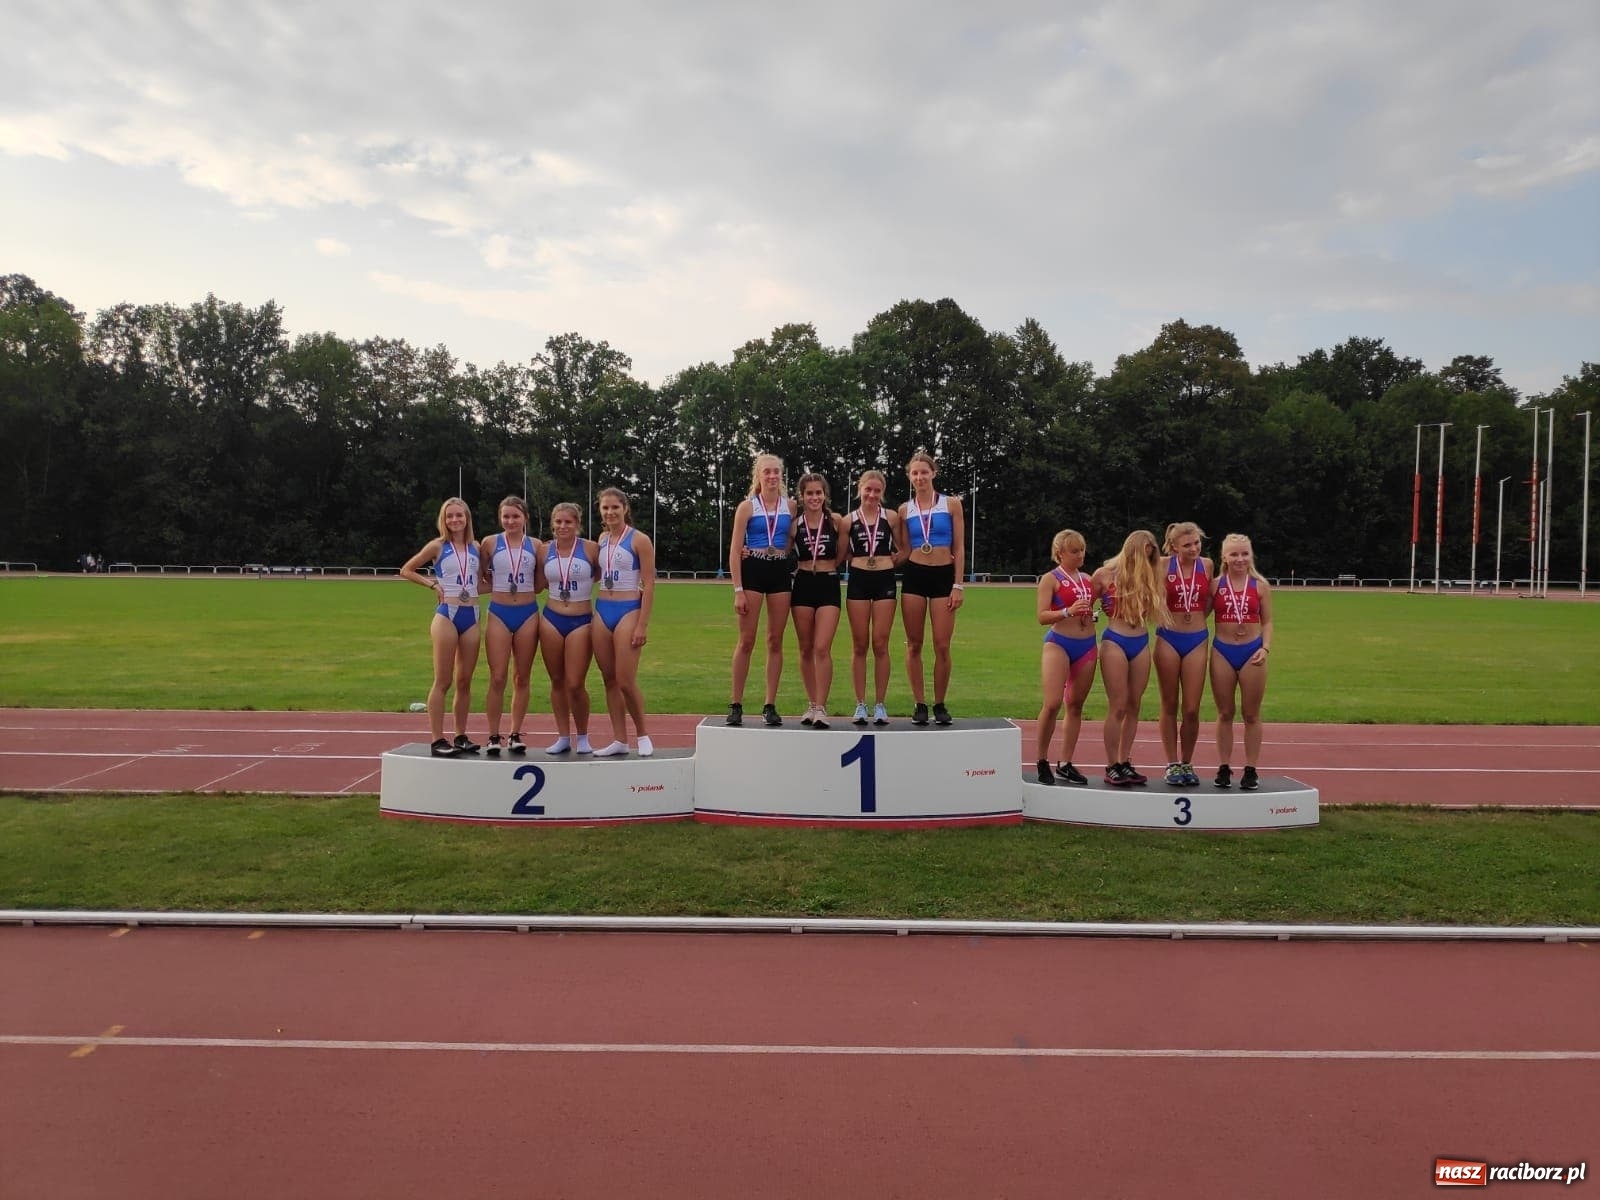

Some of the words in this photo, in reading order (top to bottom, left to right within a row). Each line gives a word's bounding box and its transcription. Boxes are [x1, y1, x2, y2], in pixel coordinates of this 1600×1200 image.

[511, 765, 546, 815] 2
[841, 734, 876, 812] 1
[1173, 797, 1192, 826] 3
